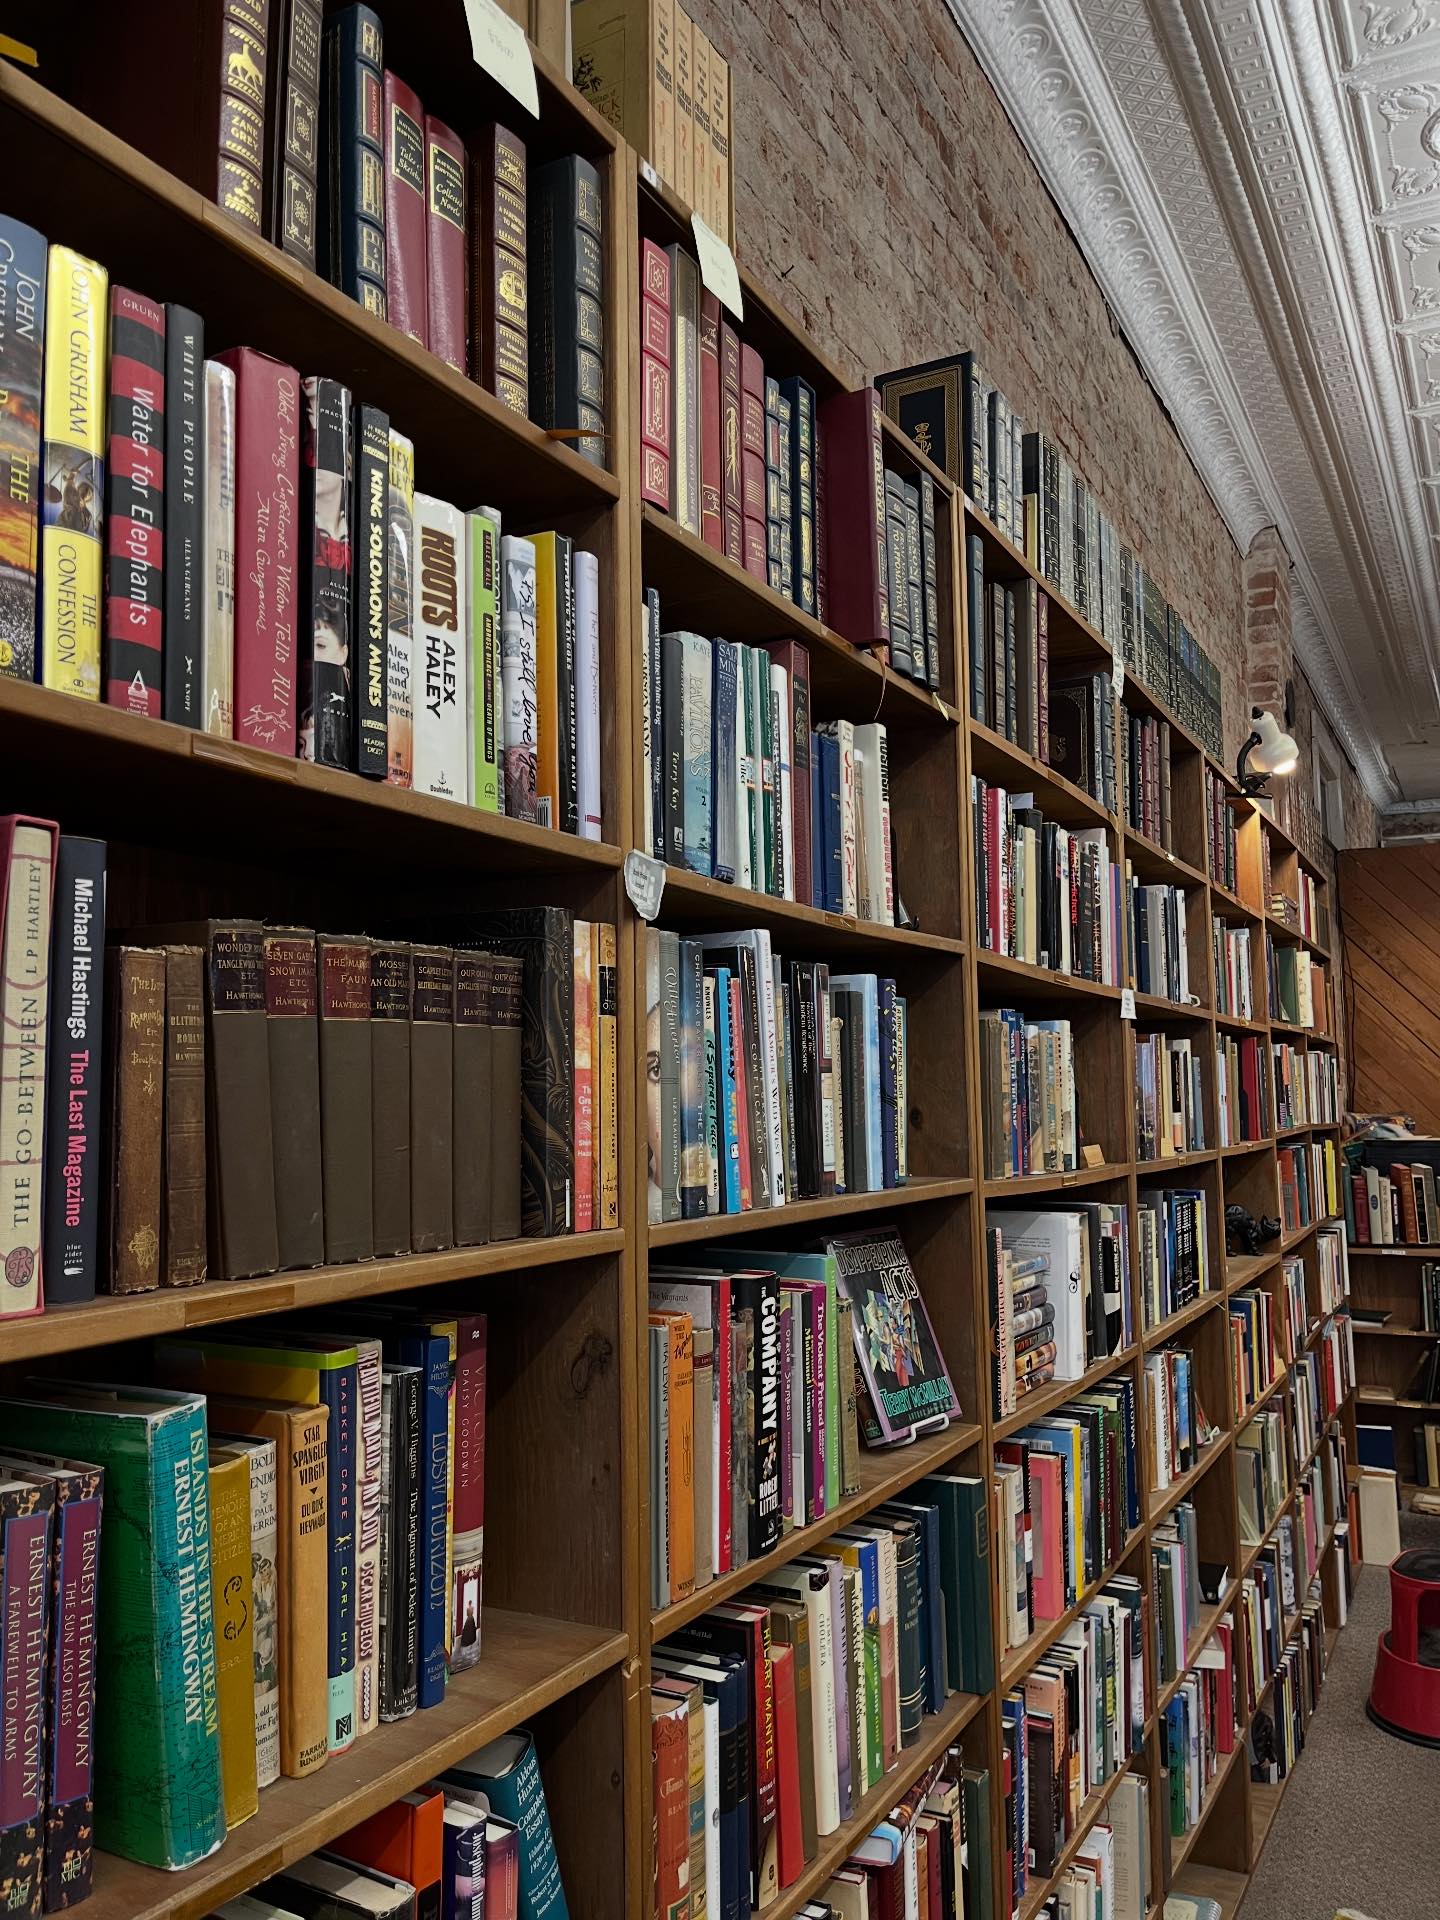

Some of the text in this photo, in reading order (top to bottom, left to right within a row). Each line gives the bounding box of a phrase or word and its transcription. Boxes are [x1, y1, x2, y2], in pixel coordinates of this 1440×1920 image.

[230, 126, 258, 151] GREY
[232, 114, 258, 140] ZANE
[436, 183, 463, 208] Collected
[14, 267, 41, 341] JOHN
[121, 297, 161, 324] GRUEN
[68, 261, 91, 437] JOHN GRISHAM
[183, 334, 194, 504] WHITE PEOPLE
[10, 455, 30, 503] THE
[126, 386, 154, 626] Water for Elephants
[256, 491, 270, 544] Allan
[183, 568, 192, 621] GURGANUS
[274, 564, 292, 619] Widow
[368, 468, 384, 708] KING SOLOMON'S MINES
[421, 526, 458, 633] ROOTS
[57, 544, 77, 665] CONFESSION
[82, 593, 97, 629] THE
[274, 623, 291, 664] Tells
[388, 674, 408, 691] and
[425, 634, 442, 719] HALEY
[442, 640, 457, 706] ALEX
[689, 673, 706, 777] PAVILIONS
[430, 784, 454, 796] Doubleday
[670, 751, 680, 811] Terry Kay
[701, 795, 707, 807] 2
[775, 820, 784, 866] KINCAID
[26, 863, 41, 976] L P HARTLEY
[266, 951, 292, 962] SEVEN
[269, 966, 294, 976] SNOW
[327, 958, 346, 968] THE
[341, 975, 367, 985] FAUN
[370, 978, 397, 988] AN OLD
[704, 986, 712, 1021] KNOWLES
[62, 878, 94, 1228] Michael Hastings The Last Magazine
[706, 1051, 717, 1110] Separate
[751, 1043, 764, 1155] COMPLICATION
[13, 996, 39, 1229] THE GO-BETWEEN
[709, 1114, 717, 1150] Peace
[63, 1258, 83, 1267] press
[64, 1250, 83, 1260] rider
[66, 1243, 82, 1252] blue
[834, 1239, 908, 1277] DISAPPEARING
[880, 1267, 920, 1303] ACTS
[817, 1303, 825, 1331] The
[761, 1296, 778, 1430] COMPANY
[817, 1330, 825, 1379] Violent
[358, 1349, 381, 1422] BEAUTIFUL
[409, 1377, 419, 1418] George
[817, 1382, 825, 1429] Friend
[880, 1387, 911, 1417] TERRY
[303, 1424, 321, 1446] STAR
[361, 1420, 382, 1470] MARIA
[460, 1368, 470, 1488] DAISY GOODWIN
[472, 1364, 485, 1483] VICTORIA
[250, 1451, 275, 1471] BOLD
[293, 1439, 328, 1470] SPANGLED
[340, 1377, 349, 1520] BASKET CASE
[408, 1431, 419, 1480] Higgins
[299, 1461, 327, 1487] VIRGIN
[361, 1482, 382, 1510] MY
[254, 1503, 275, 1519] PAUL
[409, 1487, 419, 1513] The
[430, 1431, 447, 1611] LOST HORIZON
[299, 1512, 326, 1537] HEYWARD
[360, 1507, 381, 1552] SOUL
[407, 1513, 419, 1570] Judgment
[174, 1456, 203, 1726] ERNEST HEMINGWAY
[189, 1427, 218, 1738] ISLANDS IN THE STREAM
[340, 1566, 348, 1618] CARL
[408, 1586, 418, 1617] Deke
[358, 1558, 375, 1658] OSCAR HIJUELOS
[61, 1580, 77, 1727] THE SUN ALSO RISES
[75, 1528, 97, 1768] ERNEST HEMINGWAY
[407, 1619, 417, 1665] Hunter
[818, 1612, 826, 1667] CHOLERA
[4, 1585, 22, 1761] A FAREWELL TO ARMS
[22, 1535, 46, 1799] ERNEST HEMINGWAY
[763, 1627, 774, 1770] HILARY MANTEL
[515, 1756, 537, 1791] Aldous
[517, 1769, 540, 1807] Huxley
[524, 1807, 547, 1841] Essays
